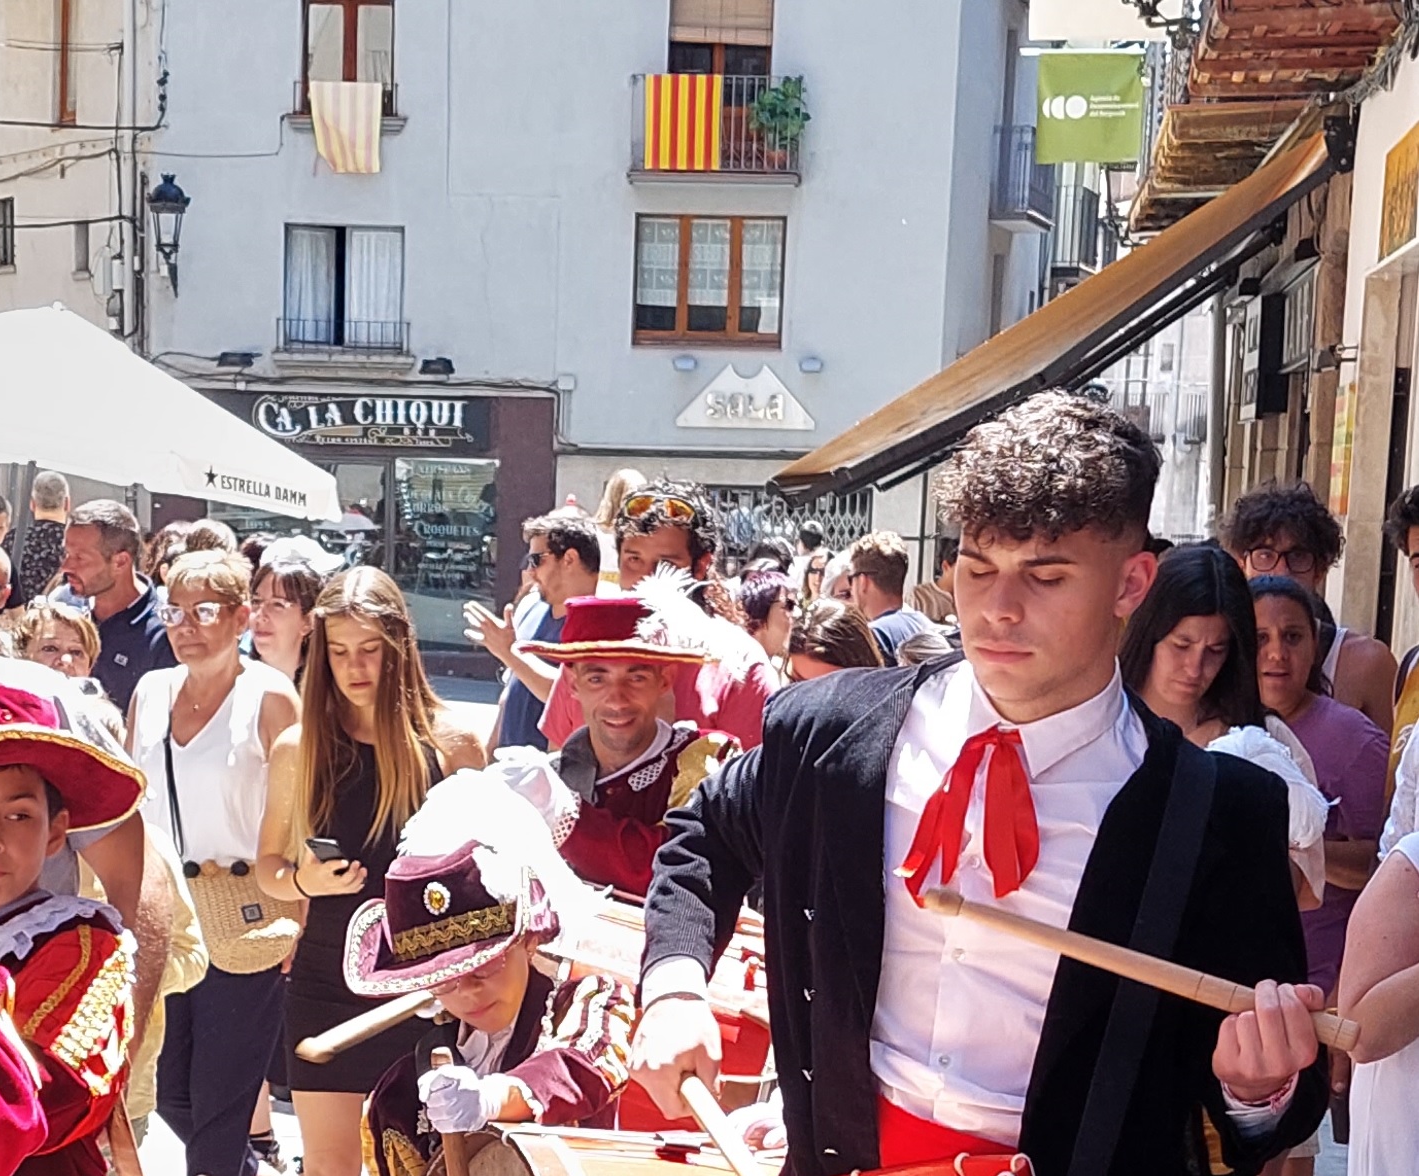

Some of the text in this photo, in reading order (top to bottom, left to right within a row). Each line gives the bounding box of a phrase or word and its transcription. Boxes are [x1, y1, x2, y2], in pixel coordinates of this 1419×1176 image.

[258, 399, 467, 436] CA LA CHIQUI
[706, 393, 783, 420] SALA
[221, 475, 307, 507] ESTRELLA DAMM
[413, 520, 481, 540] CROQUETES
